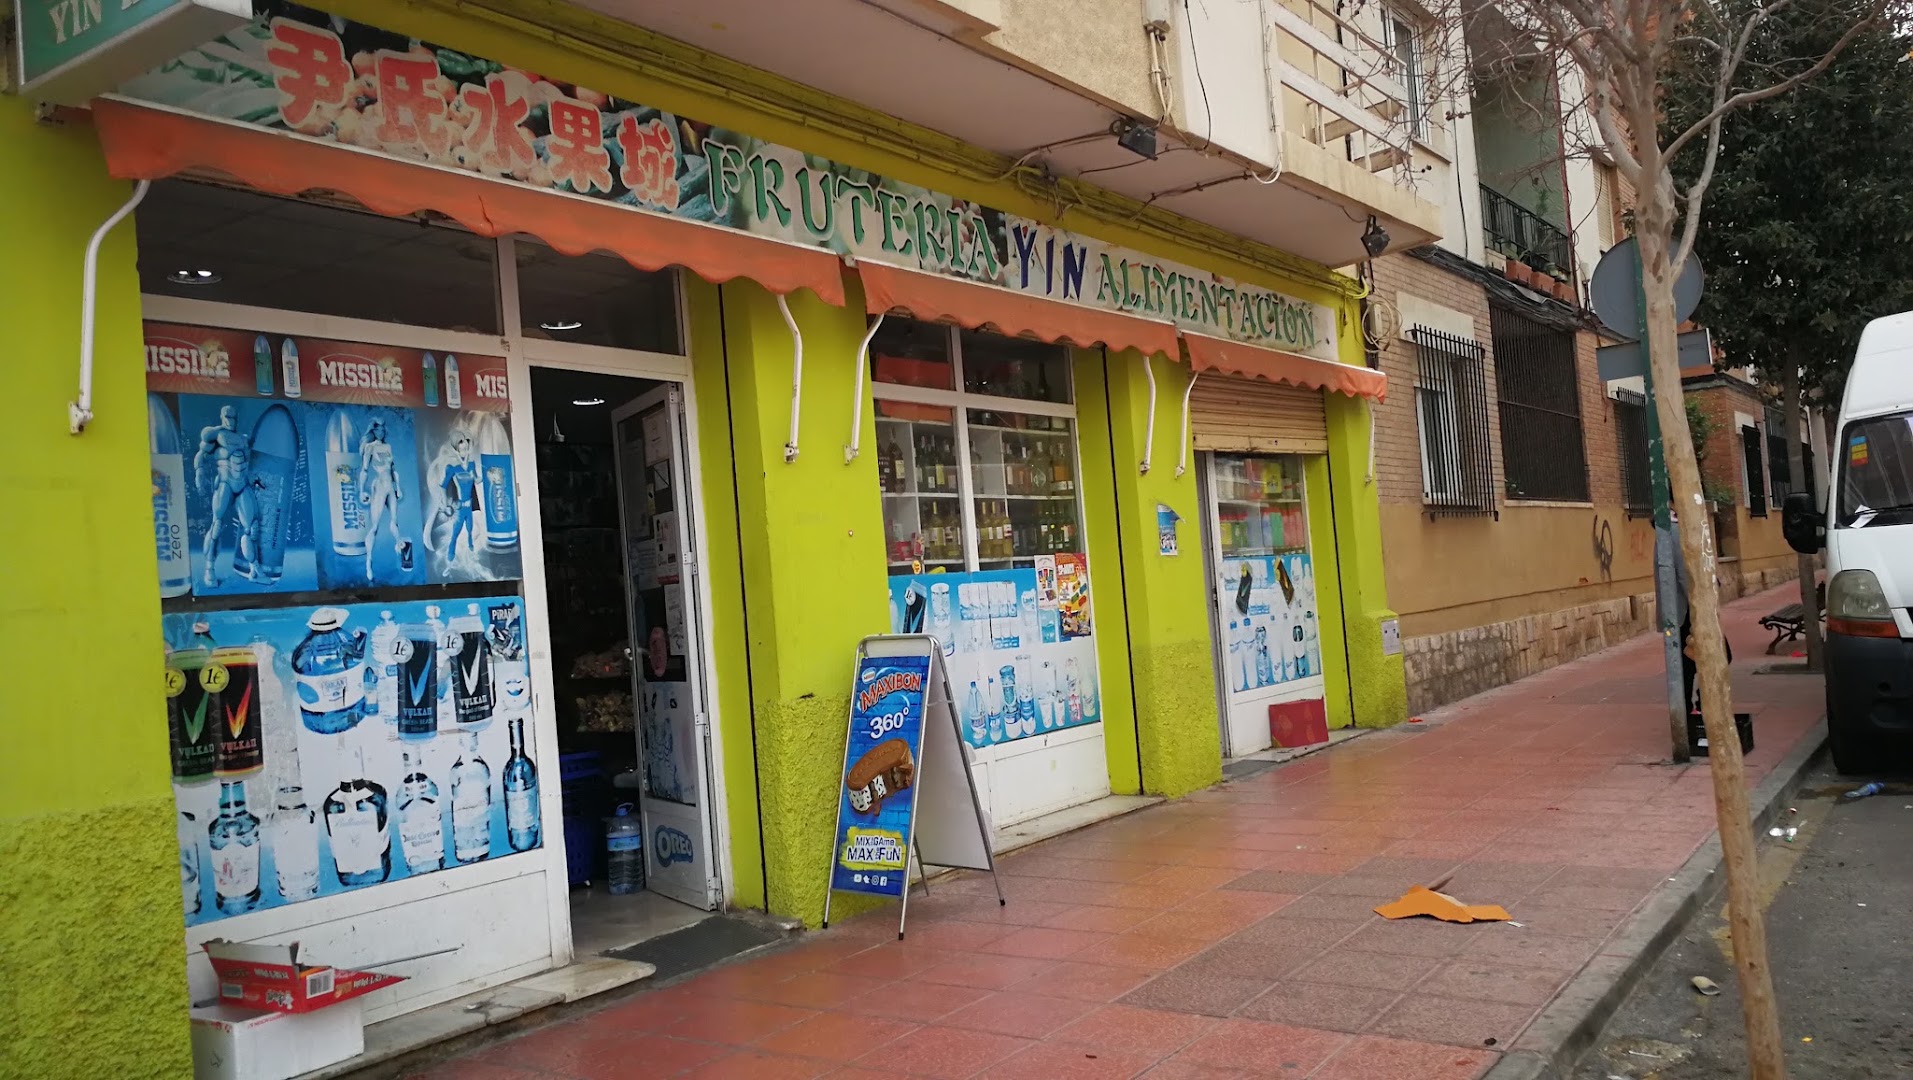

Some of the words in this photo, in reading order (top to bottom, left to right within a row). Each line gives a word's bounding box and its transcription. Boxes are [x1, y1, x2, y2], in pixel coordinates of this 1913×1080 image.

[267, 17, 679, 211] 尹氏水果城
[702, 138, 1000, 280] FRUTERIA
[1012, 223, 1087, 302] YIN
[1097, 252, 1317, 350] ALIMENTACION
[318, 360, 404, 391] MISSILE
[170, 524, 181, 560] zero
[394, 641, 408, 656] 1€
[446, 635, 458, 649] 1€
[205, 668, 223, 685] 1€
[860, 672, 922, 713] MAXIBON
[870, 706, 909, 739] 360°
[220, 738, 257, 754] VULKAN
[657, 830, 693, 859] OREO
